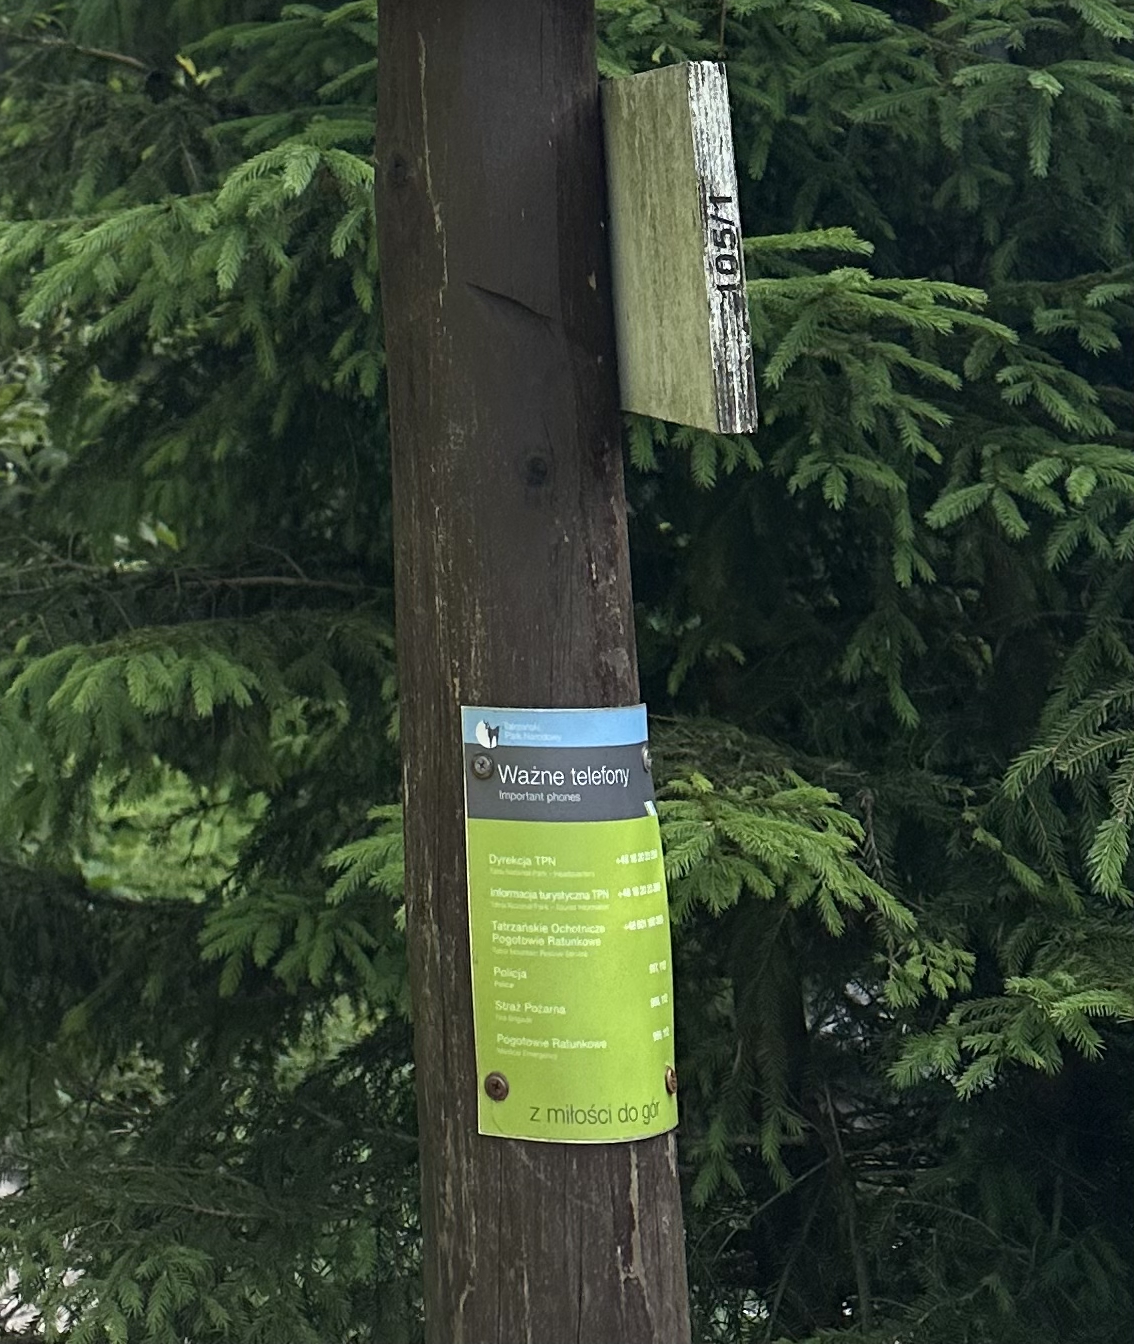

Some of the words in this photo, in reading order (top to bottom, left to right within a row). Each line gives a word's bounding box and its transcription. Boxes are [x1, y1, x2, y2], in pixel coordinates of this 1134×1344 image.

[709, 196, 739, 292] 105/1
[498, 764, 564, 786] Ważne
[571, 765, 630, 788] telefony
[499, 790, 544, 802] Important
[547, 791, 581, 804] phones
[535, 855, 556, 866] TPN
[529, 1106, 541, 1123] z
[547, 1103, 612, 1125] miłości
[618, 1103, 639, 1124] do
[641, 1099, 661, 1126] gór
